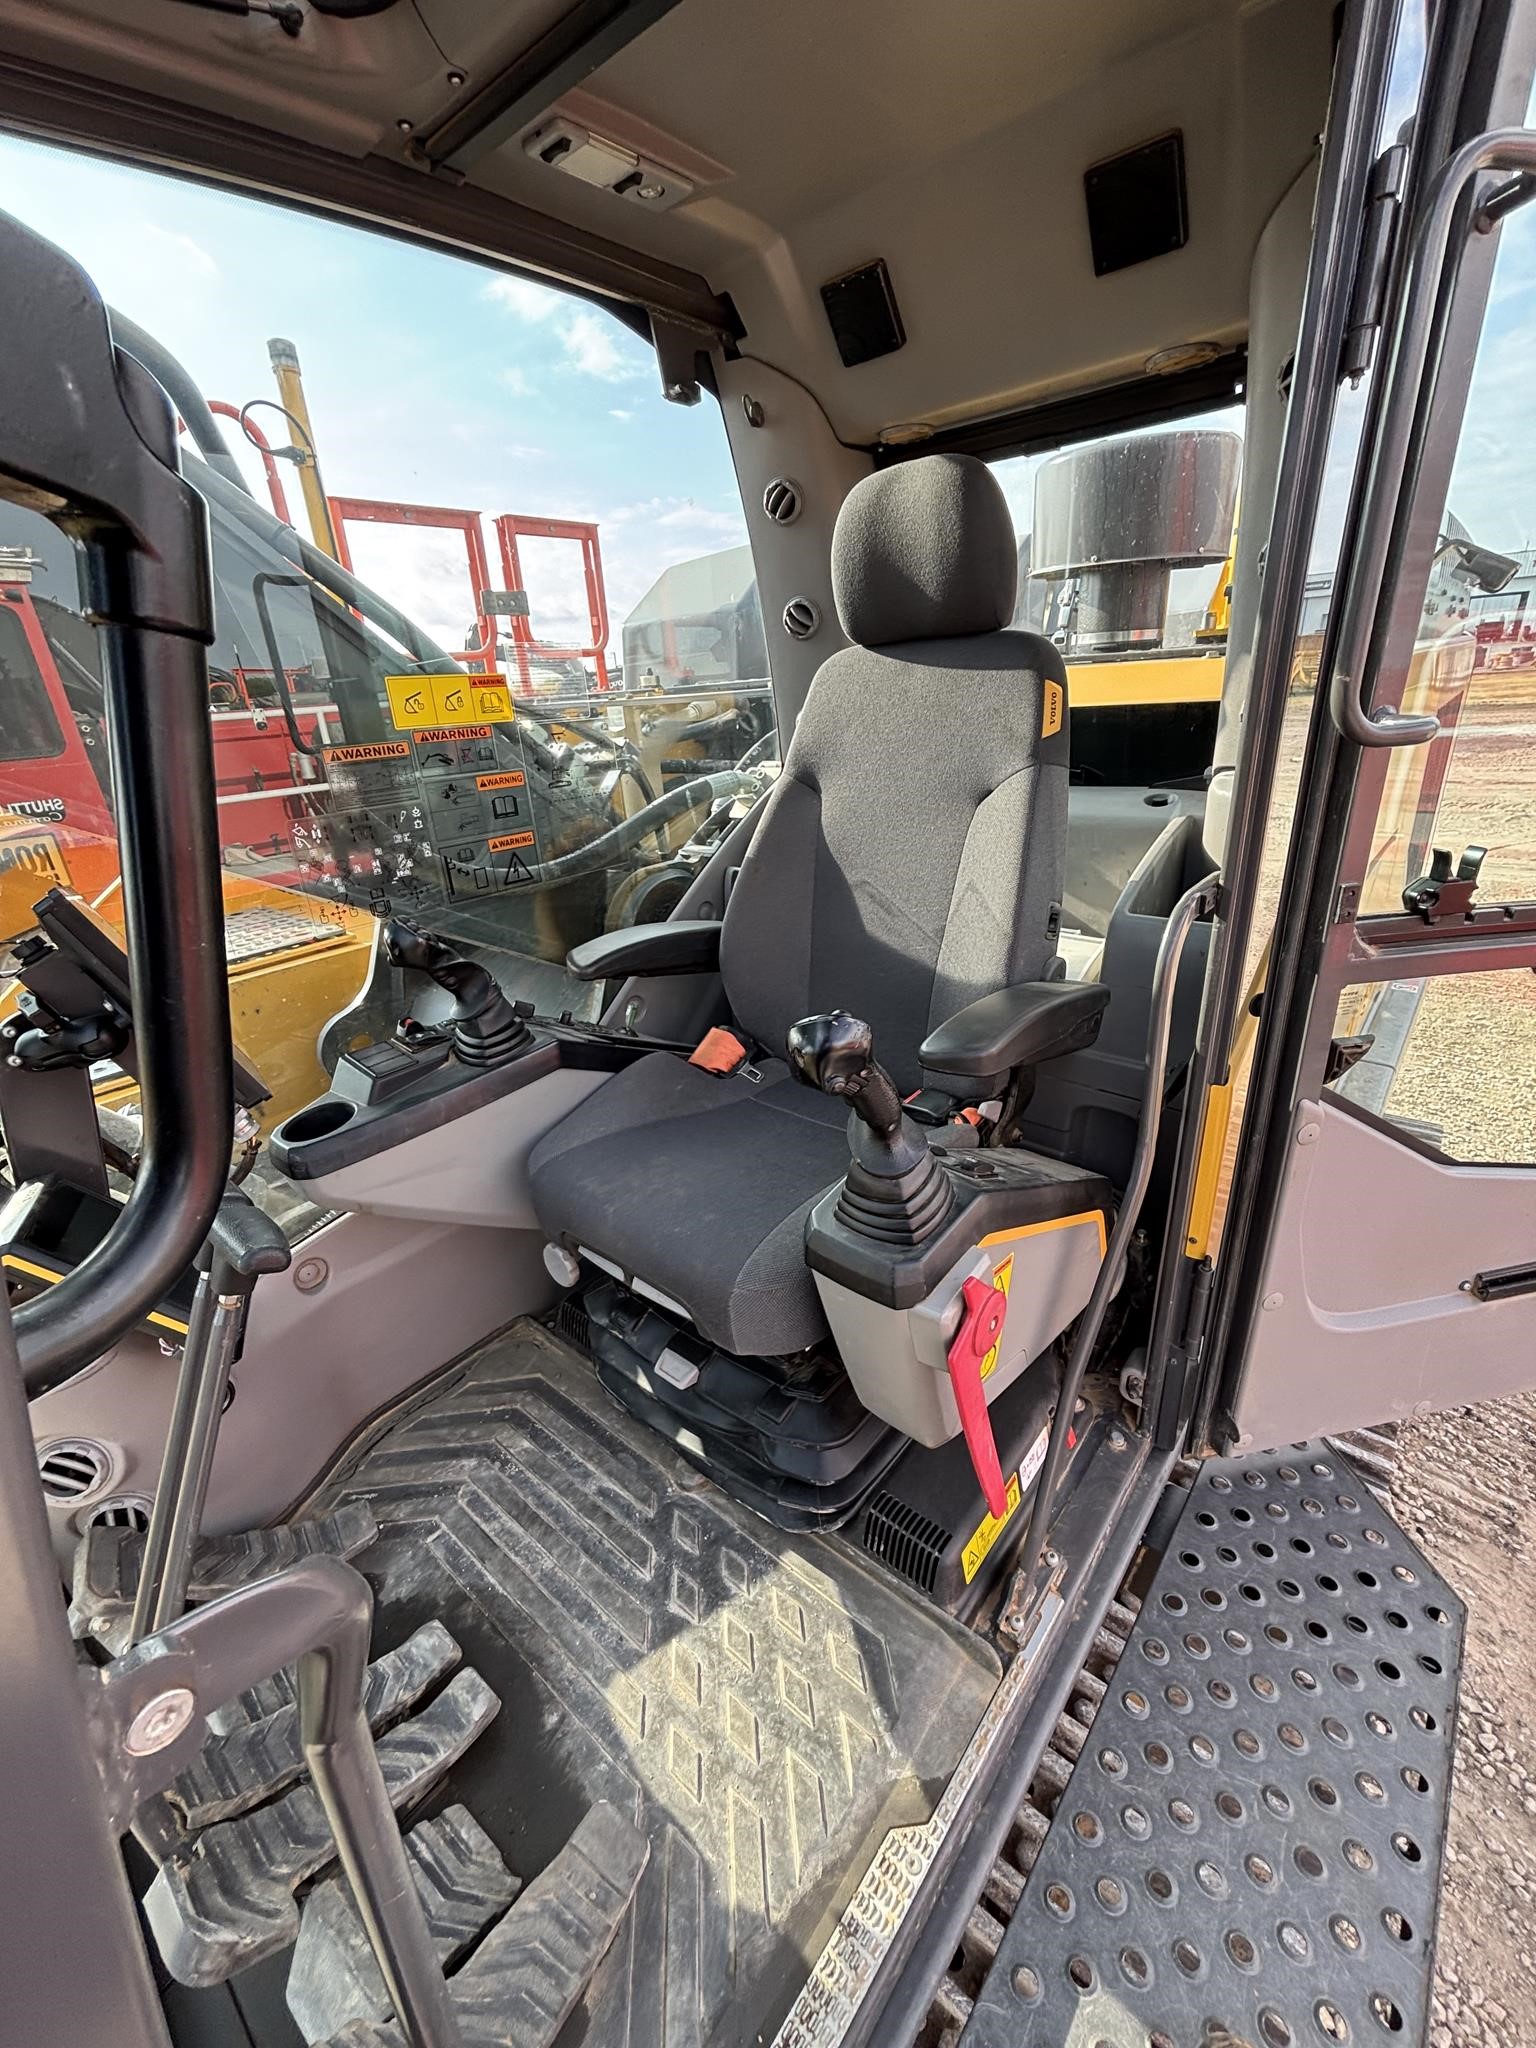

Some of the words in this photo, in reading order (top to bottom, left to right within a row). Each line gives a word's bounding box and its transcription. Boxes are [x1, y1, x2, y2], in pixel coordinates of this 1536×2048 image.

[477, 678, 505, 686] WARNING
[1049, 691, 1057, 726] VOLVO
[428, 727, 487, 742] WARNING
[341, 744, 405, 760] WARNING
[486, 775, 523, 787] WARNING
[499, 835, 532, 848] WARNING
